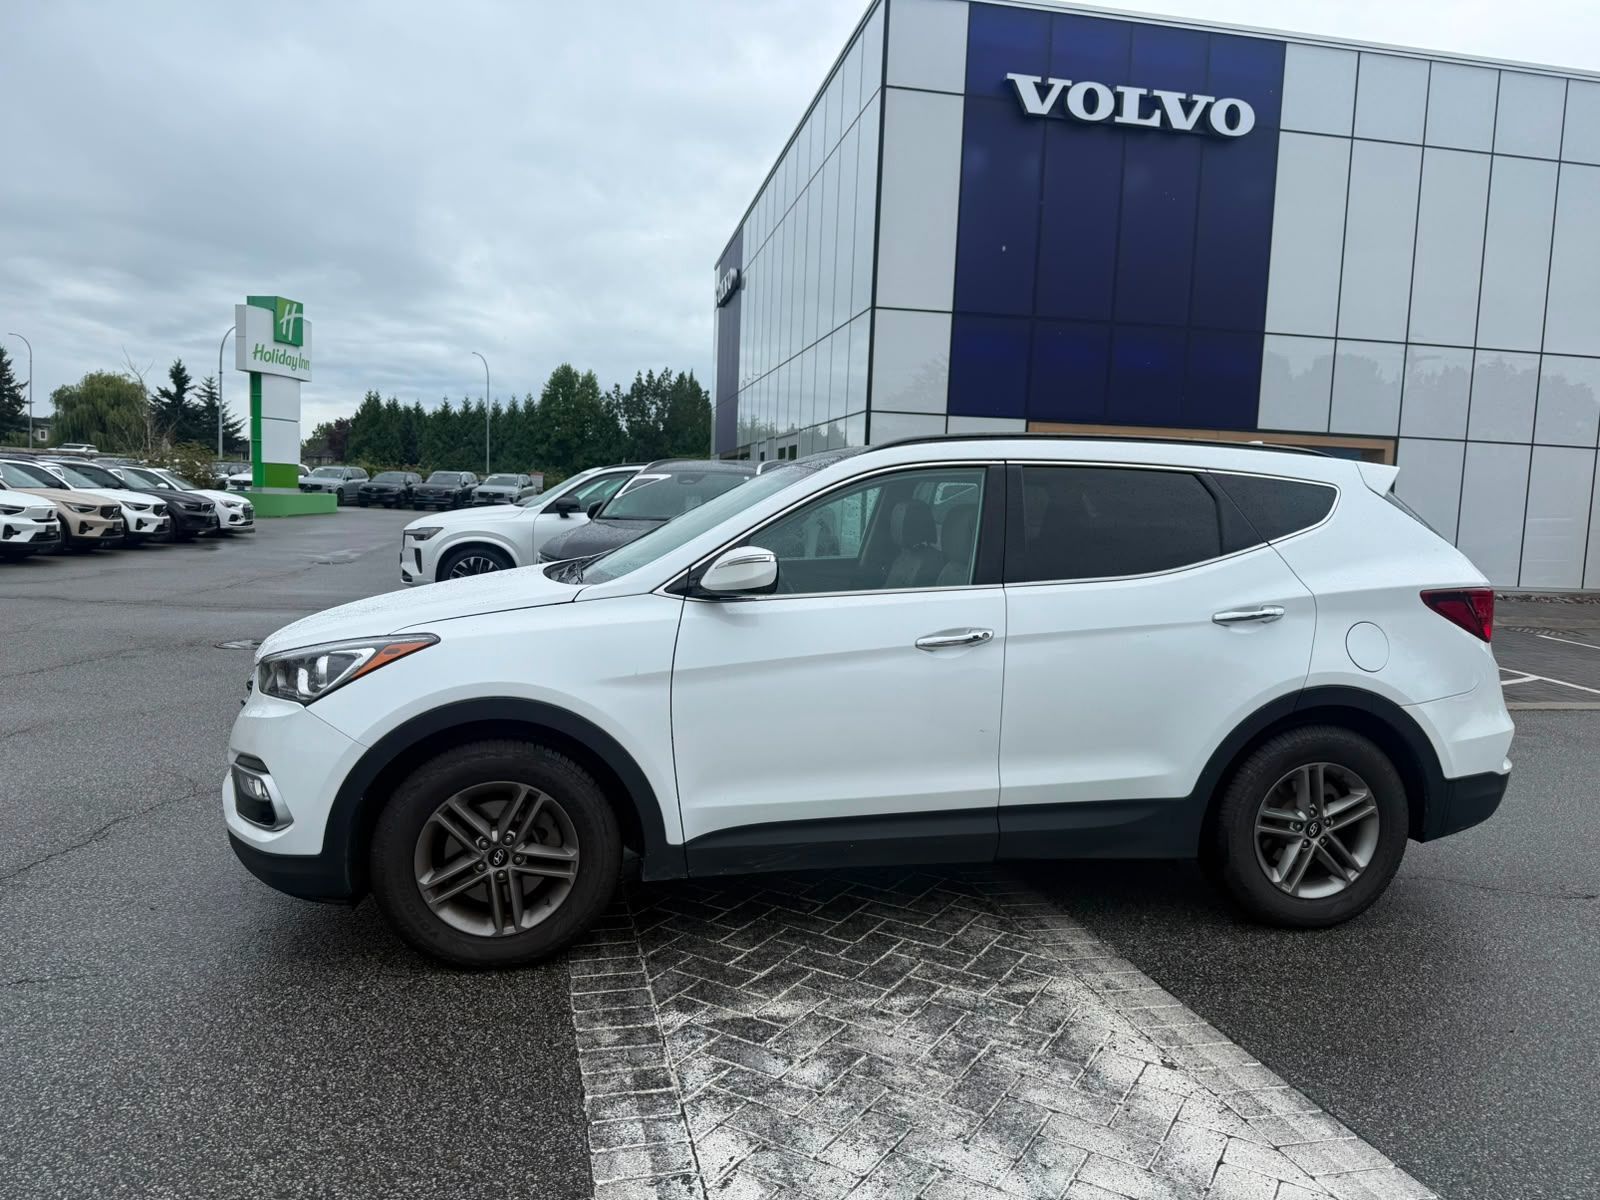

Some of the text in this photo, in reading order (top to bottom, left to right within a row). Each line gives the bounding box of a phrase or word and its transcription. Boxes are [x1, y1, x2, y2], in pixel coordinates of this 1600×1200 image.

[1005, 72, 1256, 137] VOLVO
[252, 343, 310, 371] Holiday Inn
